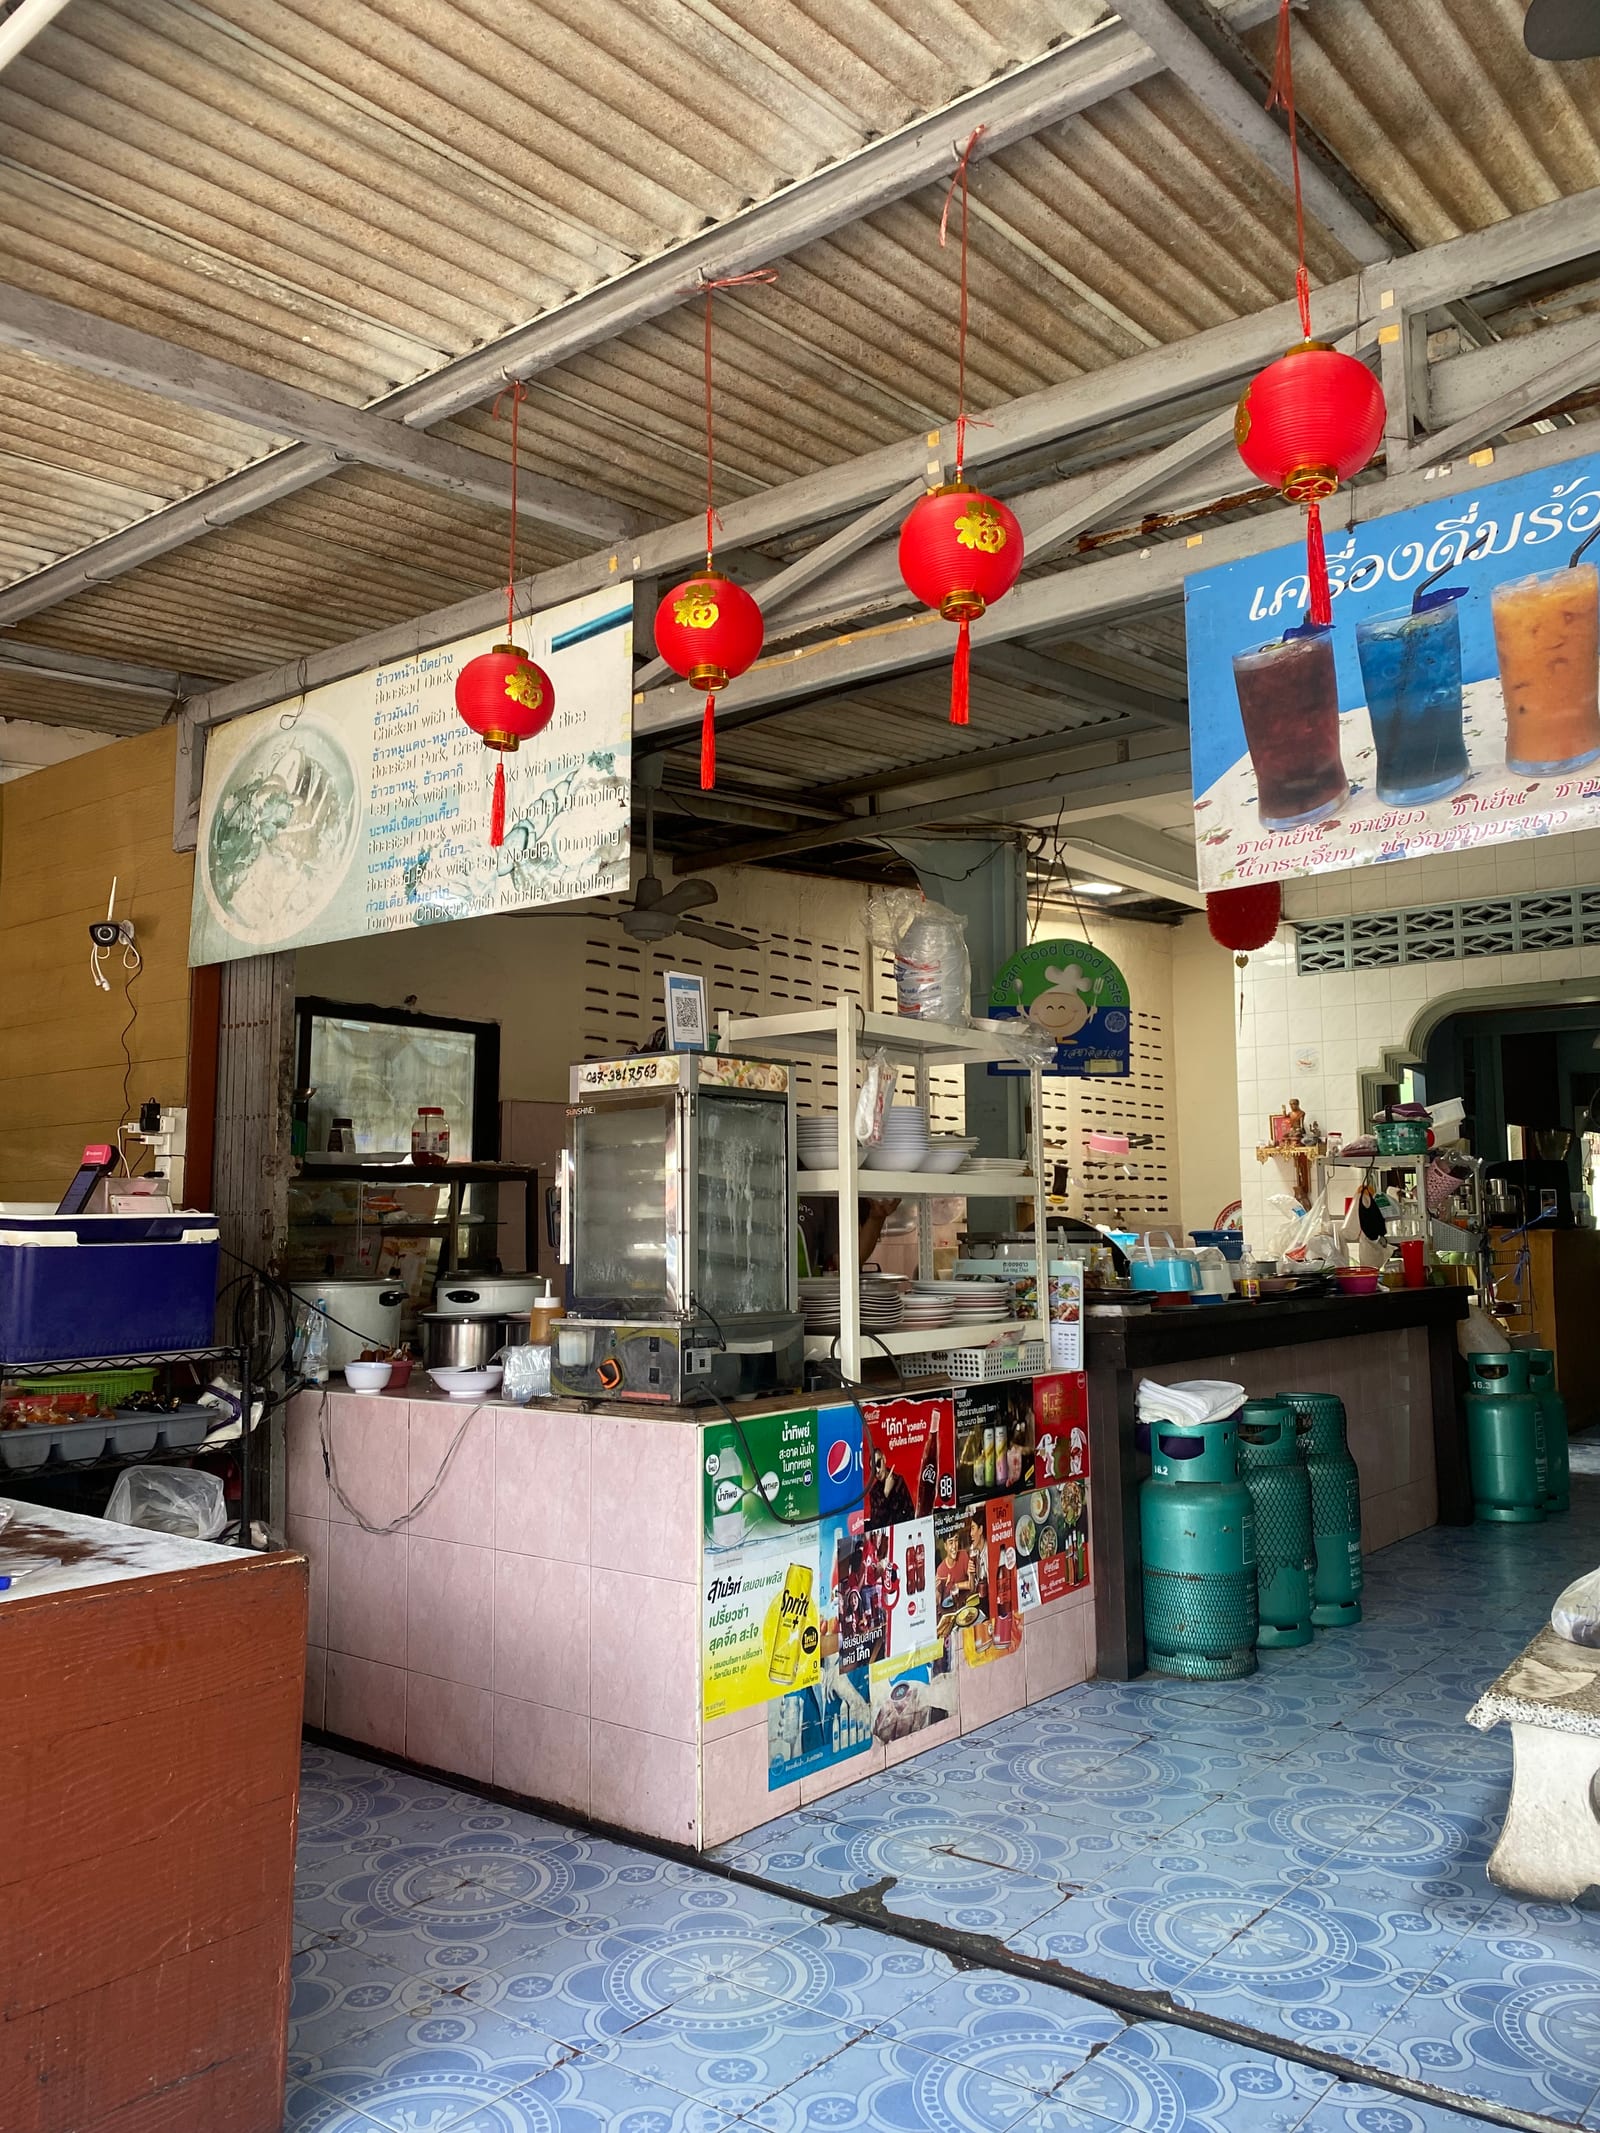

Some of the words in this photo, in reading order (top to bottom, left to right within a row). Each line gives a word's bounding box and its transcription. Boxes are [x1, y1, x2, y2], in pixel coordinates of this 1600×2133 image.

[376, 652, 453, 686] ข้าวหน้าเป็ดย่าง
[373, 719, 417, 741] Chicken
[421, 708, 446, 728] with
[374, 699, 419, 725] ข้าวมันไก่
[559, 711, 587, 728] Rice
[394, 791, 419, 811] Pork
[423, 785, 448, 803] with
[524, 758, 552, 778] with
[557, 752, 585, 770] Rice
[451, 817, 477, 835] with
[1236, 823, 1325, 855] ชาดำเย็น
[1349, 809, 1425, 835] ชาเขียว
[1452, 786, 1527, 817] ชาเย็น
[446, 855, 473, 877] with
[559, 828, 621, 853] Dumpling
[1237, 841, 1356, 878] น้ำกระเจี๊ยบ
[416, 901, 465, 921] Chicken
[467, 893, 495, 912] with
[552, 873, 616, 896] Dumpling
[993, 962, 1021, 1003] Clean
[1020, 943, 1059, 966] Food
[1063, 943, 1103, 969] Good
[1103, 967, 1124, 1004] Taste
[782, 1421, 810, 1441] น้ำทิพย์
[779, 1447, 799, 1460] สะอาด
[799, 1439, 815, 1456] มั่นใจ
[783, 1459, 811, 1475] ในทุกหยด
[717, 1487, 738, 1502] น้ำทิพย์
[709, 1602, 749, 1628] เปรี้ยวซ่า
[709, 1624, 737, 1656] สุดจี๊ด
[739, 1622, 759, 1642] สะใจ
[856, 1644, 871, 1662] โค้ก
